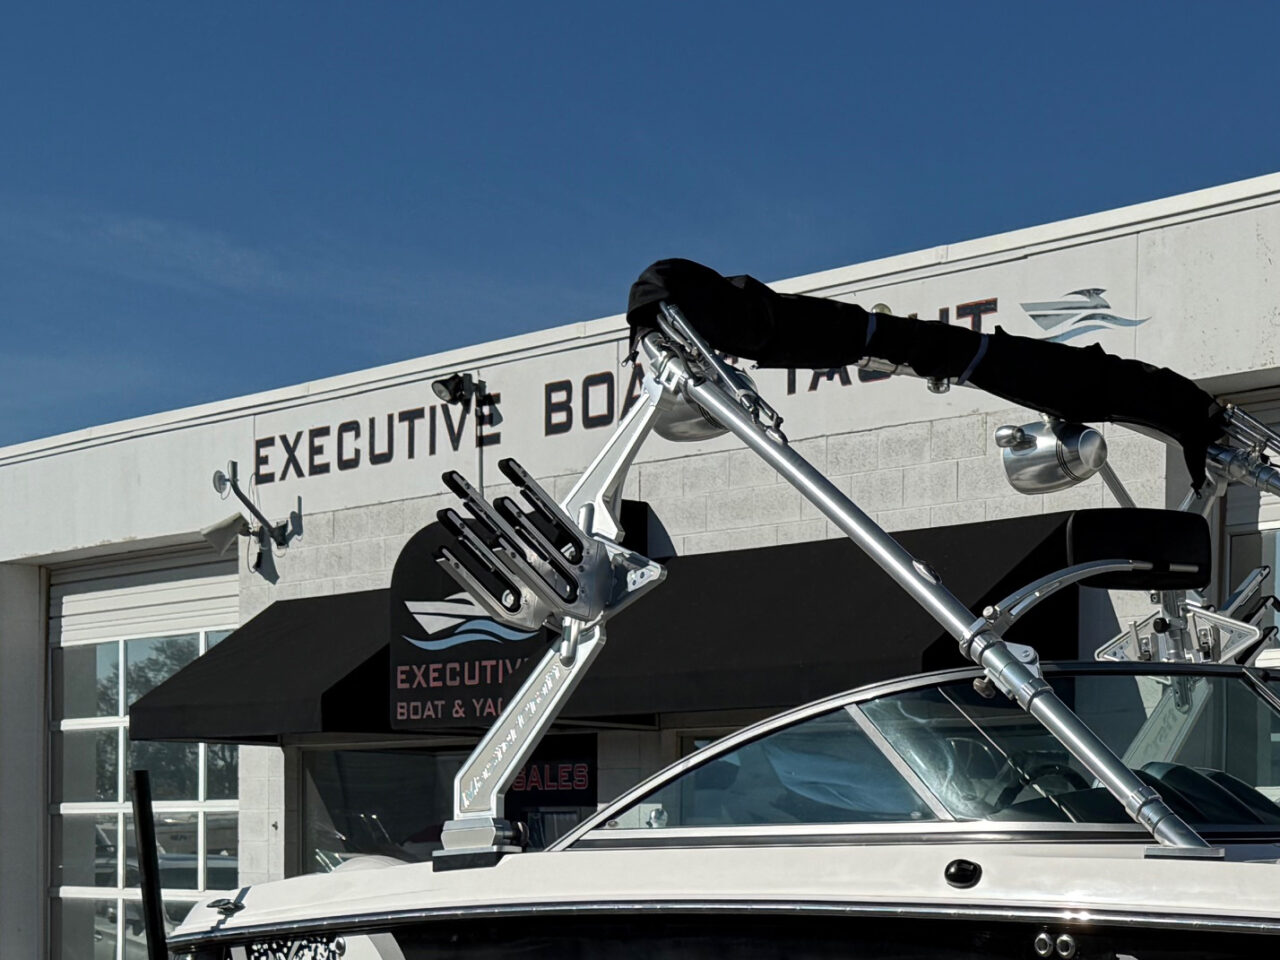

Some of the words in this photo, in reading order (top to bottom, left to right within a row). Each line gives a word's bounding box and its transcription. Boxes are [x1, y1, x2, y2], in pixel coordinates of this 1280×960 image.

[255, 393, 501, 486] EXECUTIVE
[544, 362, 646, 437] BOA
[396, 658, 524, 689] EXECUTIV
[396, 701, 446, 720] BOAT
[452, 699, 466, 718] &
[472, 698, 503, 717] YA
[512, 763, 589, 791] SALES
